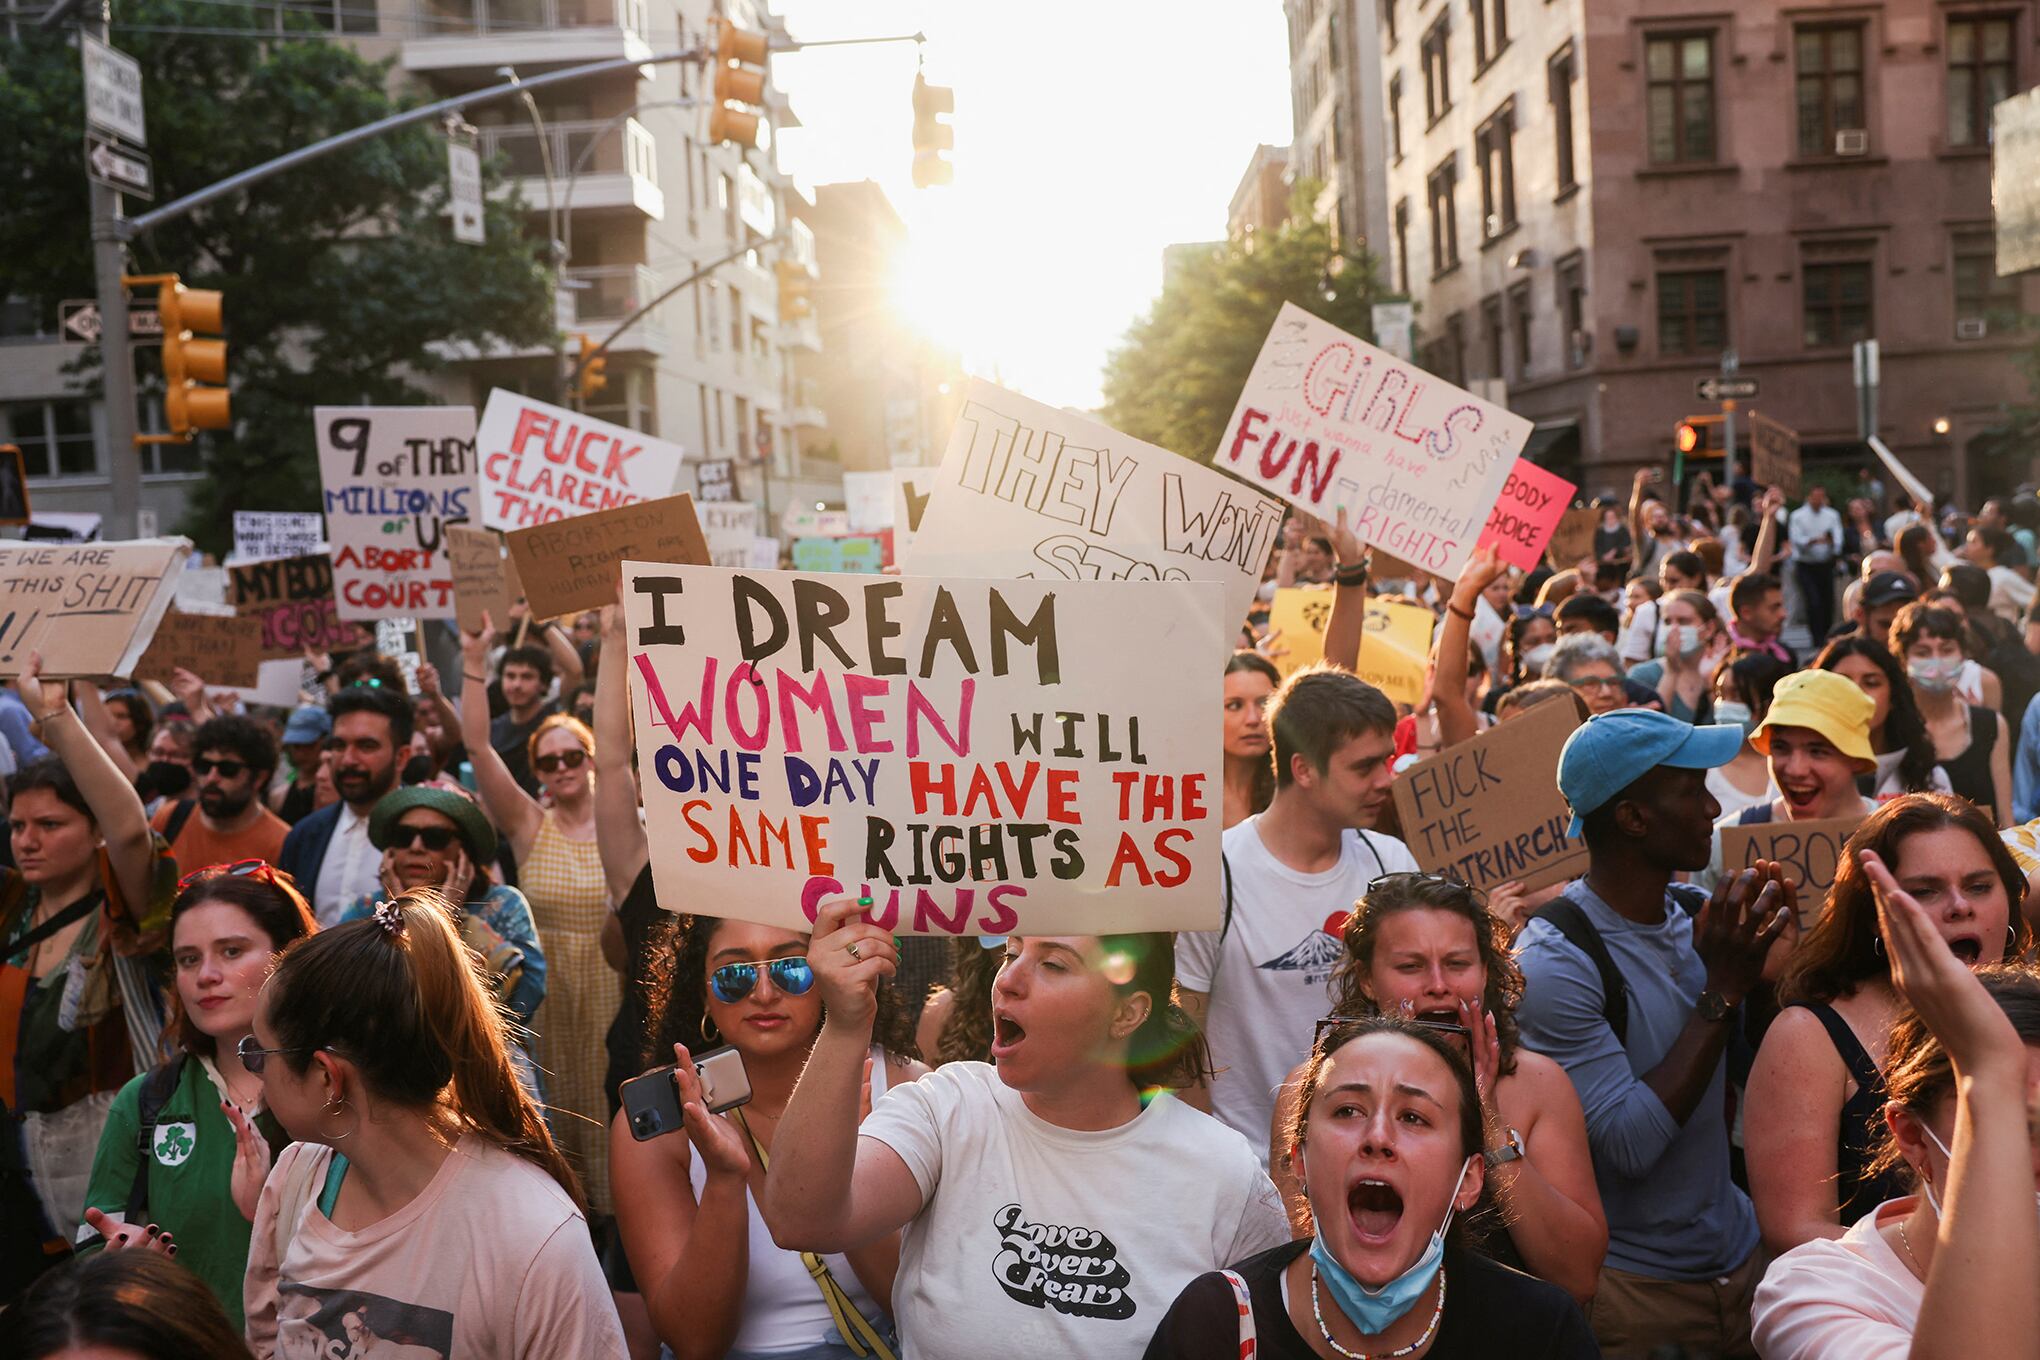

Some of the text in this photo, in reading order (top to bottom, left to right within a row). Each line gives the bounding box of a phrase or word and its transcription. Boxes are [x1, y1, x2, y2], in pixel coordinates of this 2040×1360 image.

[328, 417, 479, 476] 9 of THEM
[511, 407, 643, 487] FUCK
[1275, 401, 1429, 480] just wanna have
[325, 486, 471, 516] MILLIONS
[485, 453, 649, 511] CLAREN
[958, 400, 1139, 536] THEY
[1163, 472, 1288, 575] WONT
[1368, 472, 1474, 540] damental
[1501, 473, 1554, 512] BODY
[381, 517, 410, 534] of
[526, 512, 666, 559] ABORTION
[1356, 505, 1458, 571] RIGHTS
[16, 549, 58, 567] WE
[62, 549, 116, 567] ARE
[236, 557, 333, 603] MY BOD
[334, 545, 433, 573] ABORT
[567, 544, 641, 573] RIGHTS
[656, 534, 684, 550] ARE
[3, 572, 162, 609] THIS SHIT
[343, 579, 454, 609] COURT
[632, 574, 1062, 687] I DREAM
[633, 653, 1147, 765] WOMEN WILL
[654, 744, 1208, 825] ONE DAY HAVE THE
[1410, 747, 1502, 819] FUCK
[681, 800, 1195, 888] SAME RIGHTS AS
[1420, 808, 1481, 857] THE
[993, 1203, 1104, 1252] Love
[992, 1249, 1123, 1306] Fear
[1001, 1233, 1117, 1277] Over
